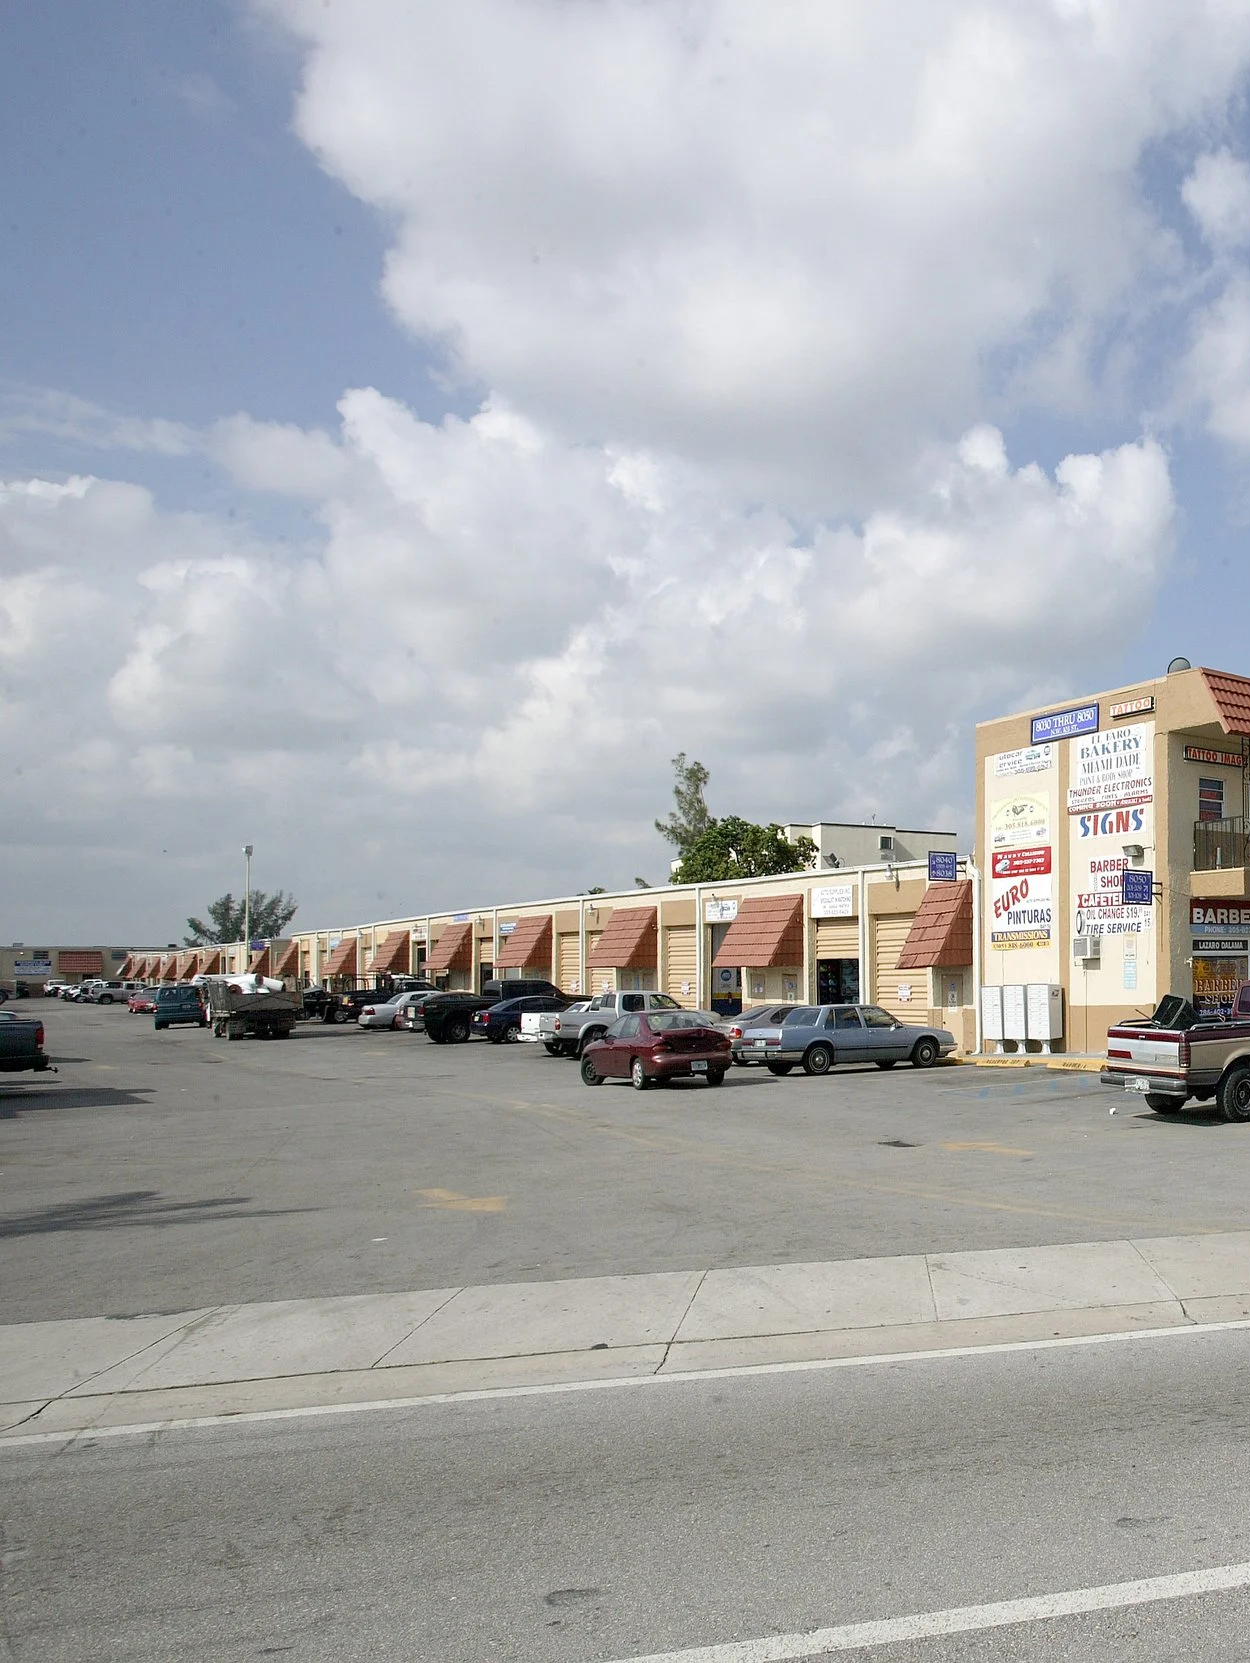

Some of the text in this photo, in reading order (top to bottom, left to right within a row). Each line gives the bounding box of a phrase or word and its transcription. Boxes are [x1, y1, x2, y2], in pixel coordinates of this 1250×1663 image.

[1112, 699, 1151, 715] TATTOO
[1035, 709, 1095, 732] 8030 THRU 8050
[1091, 728, 1131, 744] EL FARO
[1080, 736, 1142, 759] BAKERY
[1081, 752, 1141, 775] MIAMI DADE
[1187, 747, 1247, 766] TATTOO IMAG
[1069, 777, 1152, 798] THUNDER ELECTRONICS
[1095, 800, 1118, 808] SOON
[1080, 808, 1144, 838] SIGNS
[1090, 858, 1129, 873] BARBER
[1128, 874, 1147, 884] 8050
[994, 877, 1029, 919] EURO
[1007, 907, 1052, 925] PINTURAS
[1086, 909, 1096, 920] OIL
[1098, 907, 1125, 920] CHANGE
[994, 930, 1047, 941] TRANSMISSIONS
[1086, 922, 1142, 934] TIRE SERVICE
